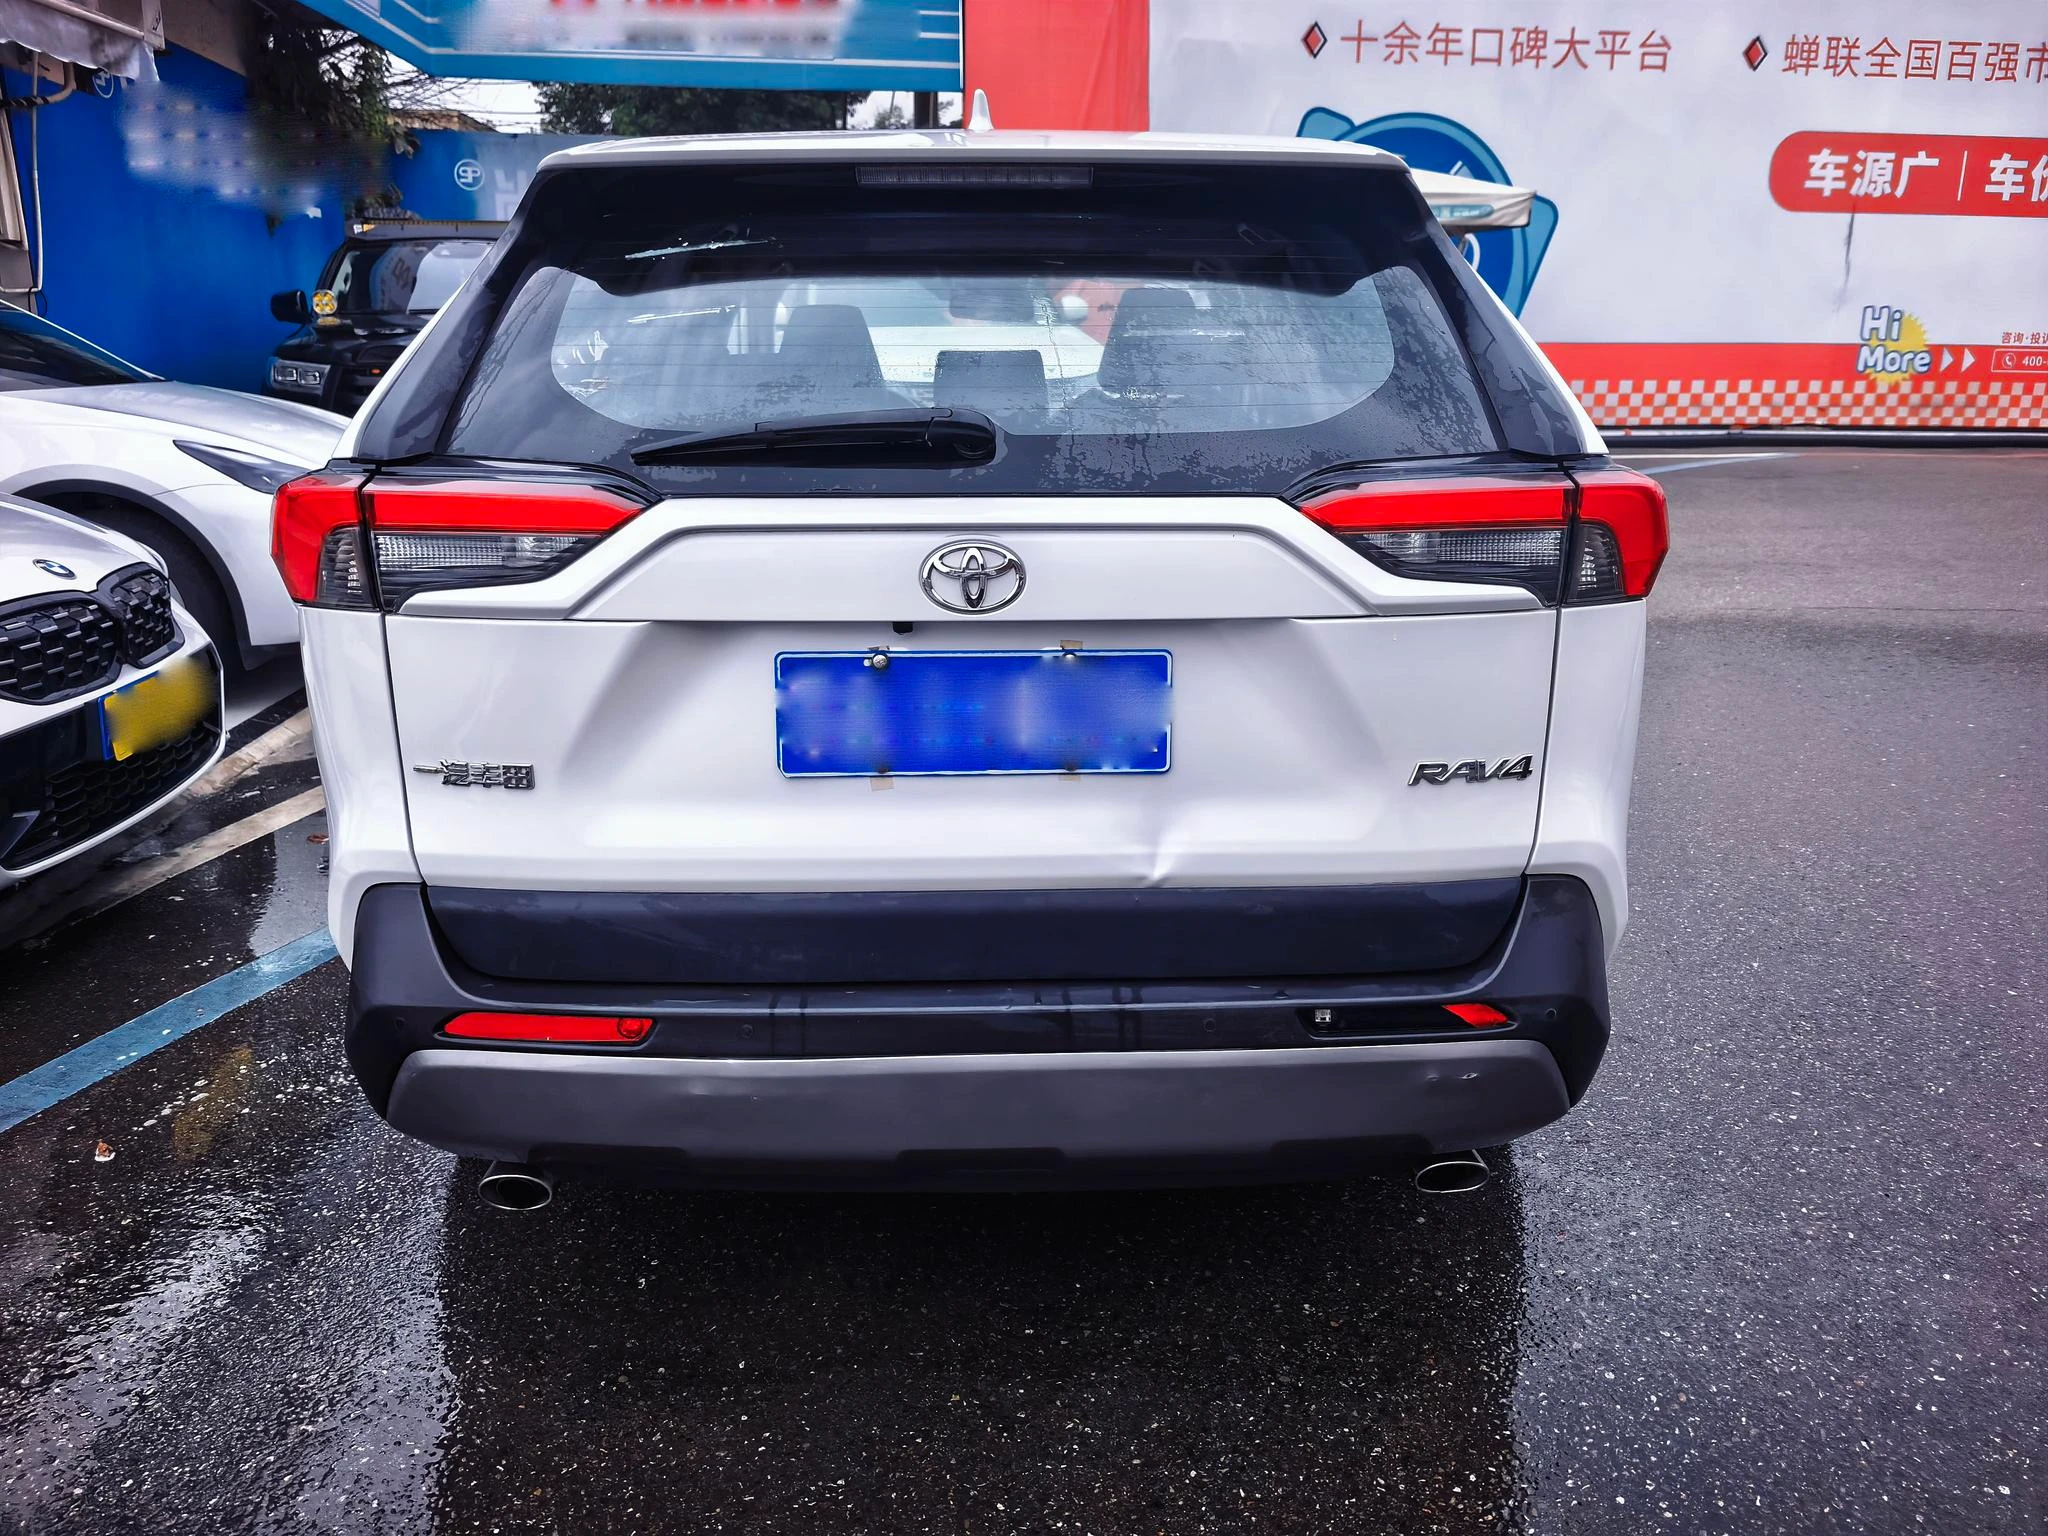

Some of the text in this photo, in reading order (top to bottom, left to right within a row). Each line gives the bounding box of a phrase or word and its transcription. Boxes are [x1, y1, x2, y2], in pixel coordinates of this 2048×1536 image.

[1340, 18, 1672, 72] 十余年口碑大平台
[1781, 33, 2048, 83] 蝉联全国百强市
[1803, 147, 1940, 199] 车源广
[1859, 305, 1904, 342] Hi
[1856, 344, 1932, 375] More
[2022, 355, 2048, 367] 400-
[412, 758, 536, 790] 一汽丰田
[1407, 753, 1534, 786] RAV4
